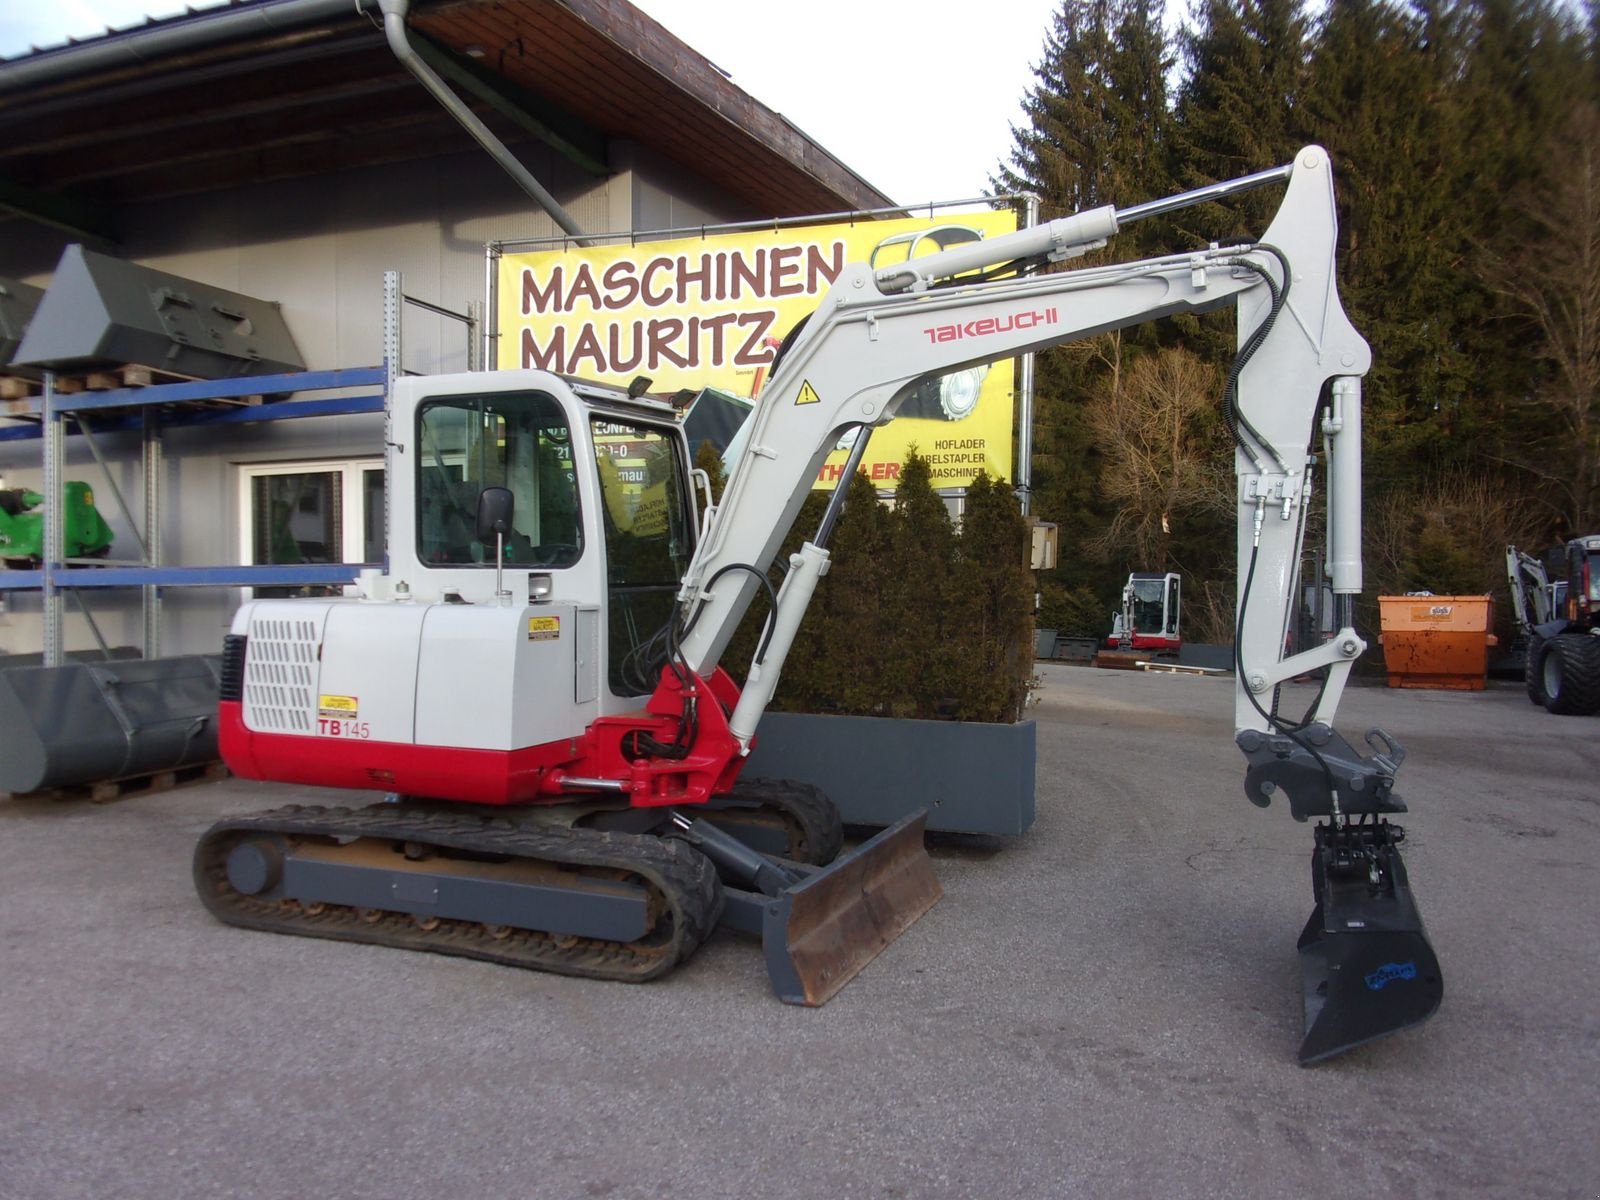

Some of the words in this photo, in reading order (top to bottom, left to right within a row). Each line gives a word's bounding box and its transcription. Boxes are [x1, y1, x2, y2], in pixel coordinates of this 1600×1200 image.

[521, 241, 844, 315] MASCHINEN
[924, 308, 1058, 344] TAKEUCHI
[521, 310, 777, 374] MAURITZ
[935, 439, 986, 450] HOFLADER
[918, 453, 985, 465] ABELSTAPLER
[318, 719, 370, 739] TB145
